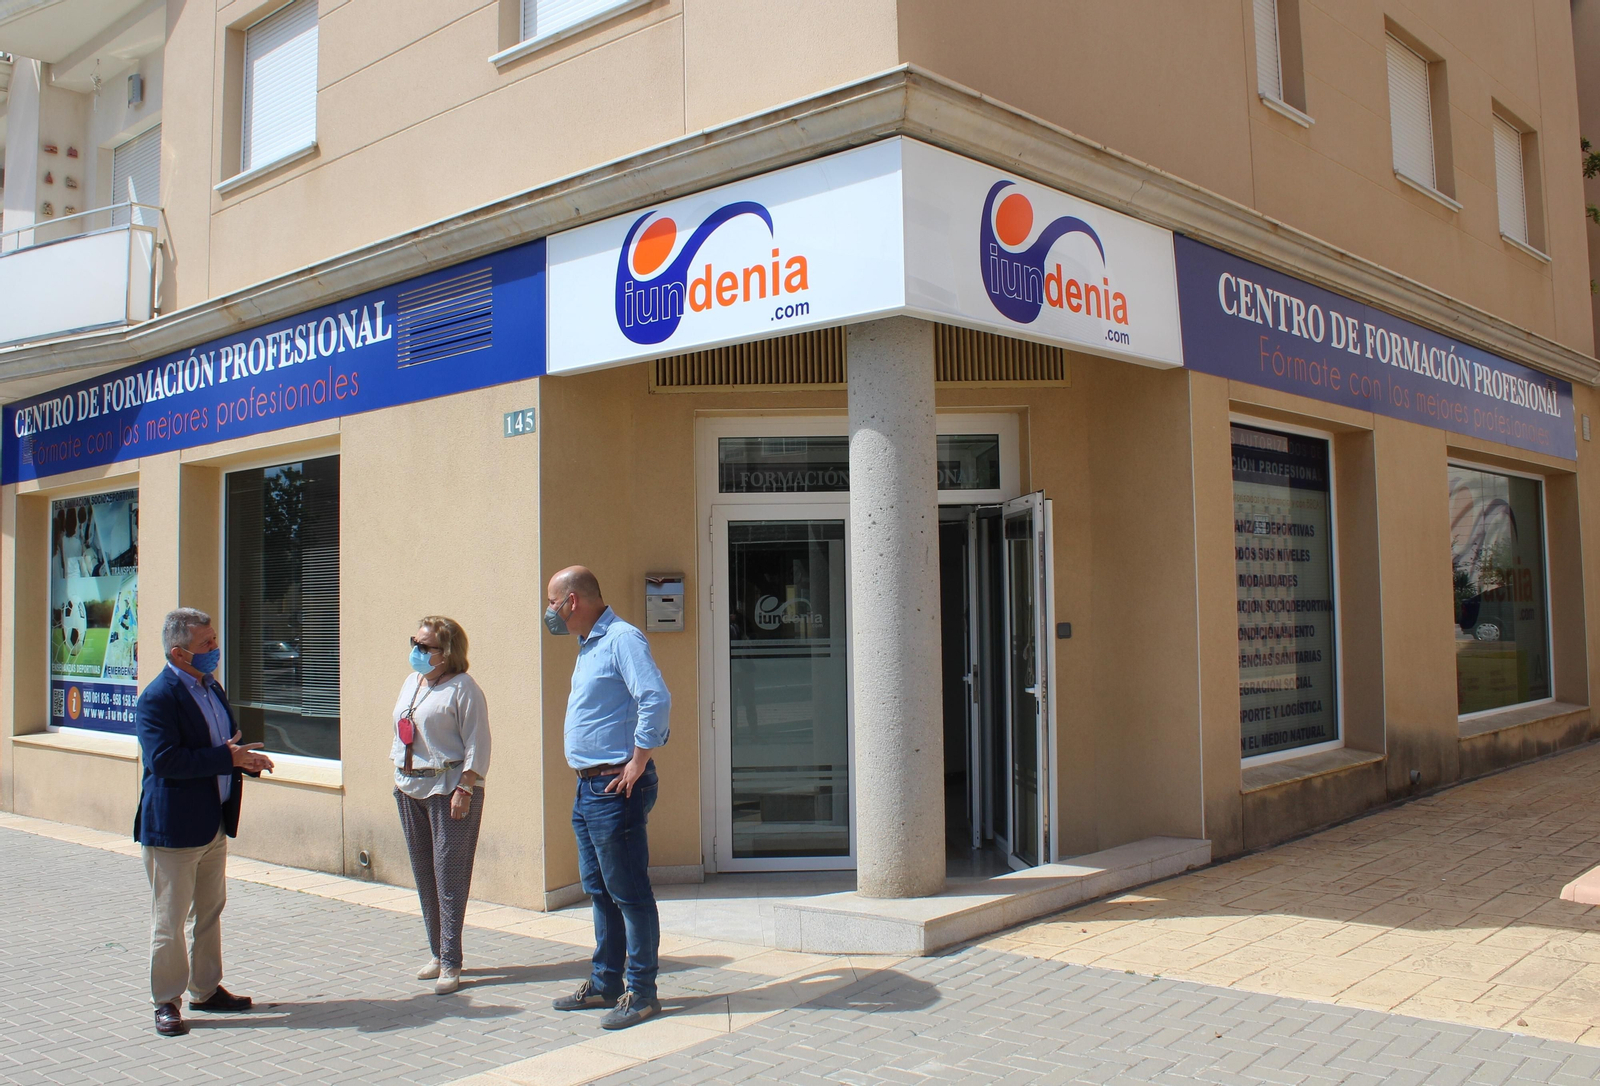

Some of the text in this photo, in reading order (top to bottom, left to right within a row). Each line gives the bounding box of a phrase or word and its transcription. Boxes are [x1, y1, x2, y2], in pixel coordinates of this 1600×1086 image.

[625, 247, 809, 328] iundenia
[989, 242, 1129, 326] iundenia
[771, 301, 810, 321] .com
[1104, 328, 1130, 345] .com
[1218, 272, 1561, 418] CENTRO DE FORMACIÓN PROFESIONAL
[14, 300, 393, 438] CENTRO DE FORMACIÓN PROFESIONAL
[1260, 335, 1550, 446] Fórmate con los mejores profesionales
[32, 365, 359, 467] Fórmate con los mejores profesionales
[506, 411, 534, 434] 145
[1240, 432, 1307, 457] AUTORIZADOS
[740, 467, 849, 487] FORMACIÓN
[1259, 460, 1323, 482] PROFESIONAL
[1266, 522, 1315, 537] DEPORTIVAS
[1258, 547, 1276, 560] SUS
[1277, 549, 1310, 562] NIVELES
[1239, 574, 1298, 588] MODALIDADES
[1265, 598, 1333, 612] SOCIODEPORTIVA
[1275, 650, 1322, 666] SANITARIAS
[1284, 676, 1312, 691] SOCIAL
[1273, 706, 1278, 718] Y
[1281, 700, 1323, 718] LOGÍSTICA
[1248, 734, 1260, 749] EL
[1262, 730, 1288, 747] MEDIO
[1290, 725, 1326, 742] NATURAL
